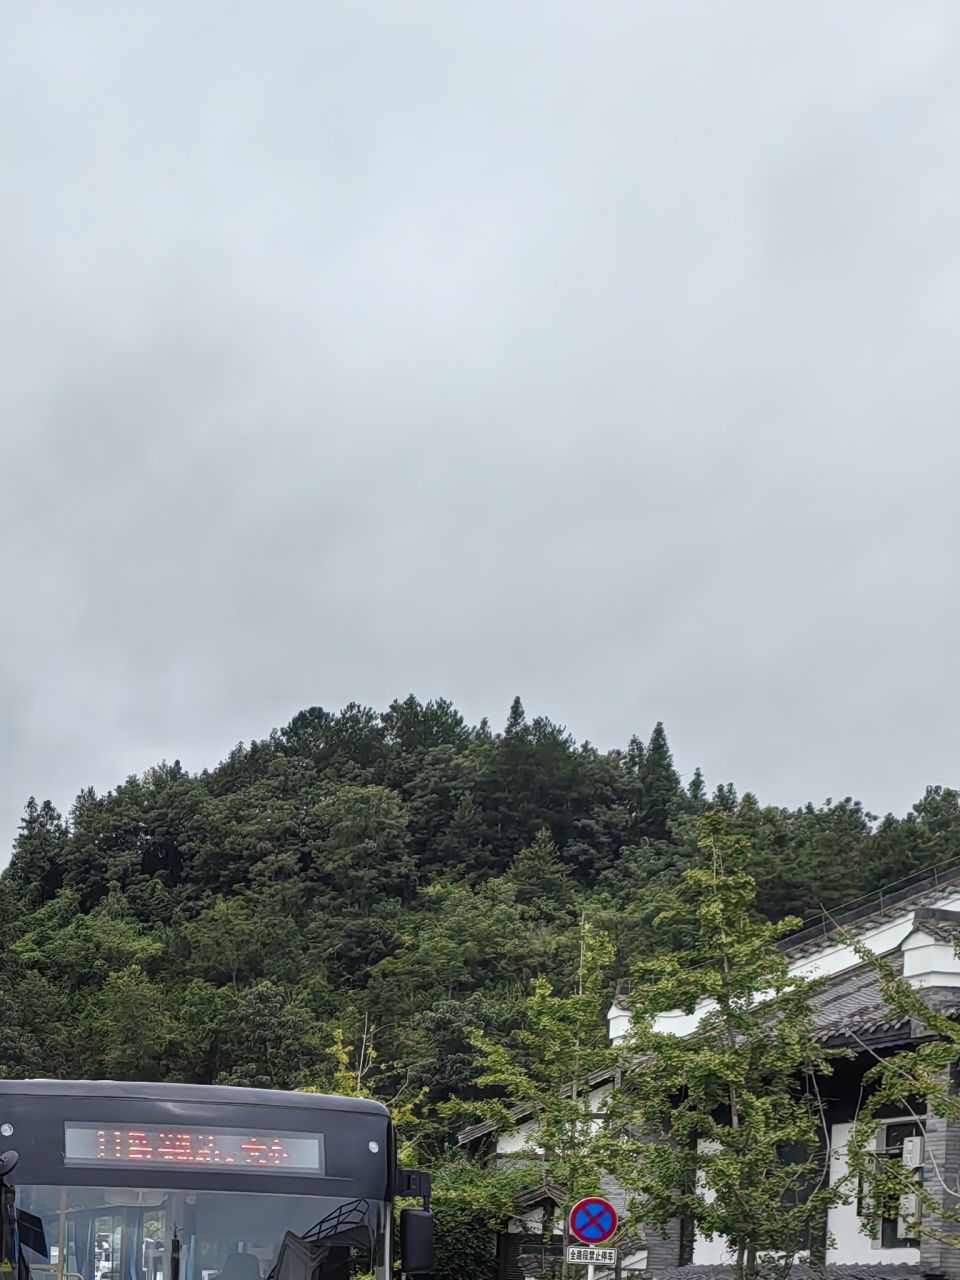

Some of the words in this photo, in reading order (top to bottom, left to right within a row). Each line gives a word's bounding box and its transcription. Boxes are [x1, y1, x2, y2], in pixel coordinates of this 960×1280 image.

[570, 1249, 614, 1262] 全路段禁止停车
